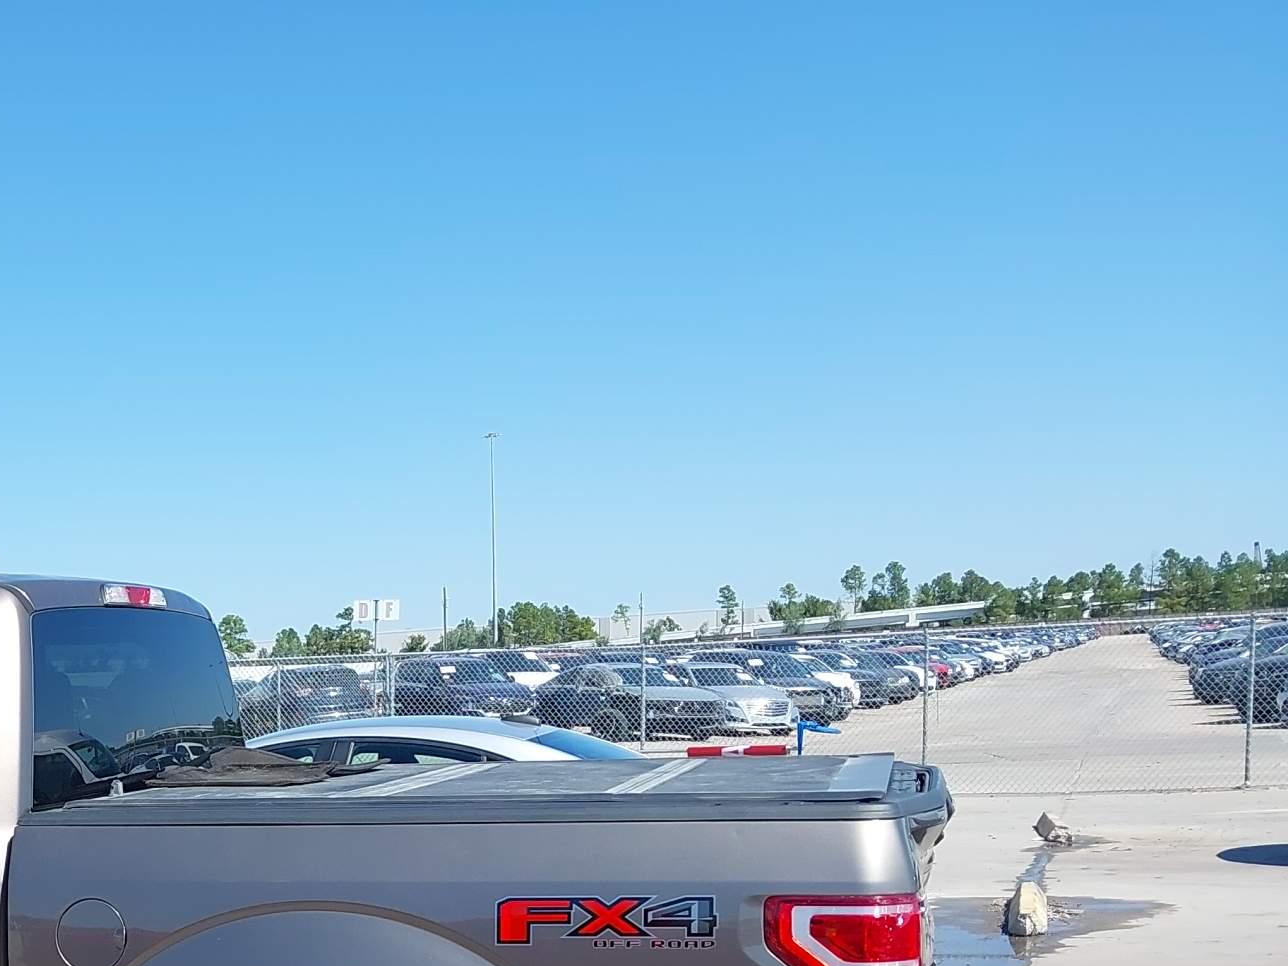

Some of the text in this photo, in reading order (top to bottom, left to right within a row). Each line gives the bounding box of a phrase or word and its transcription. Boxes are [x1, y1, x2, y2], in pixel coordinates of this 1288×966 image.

[358, 602, 369, 619] D
[385, 602, 394, 618] F
[495, 896, 718, 945] FX4
[593, 938, 717, 950] OFF ROAD
